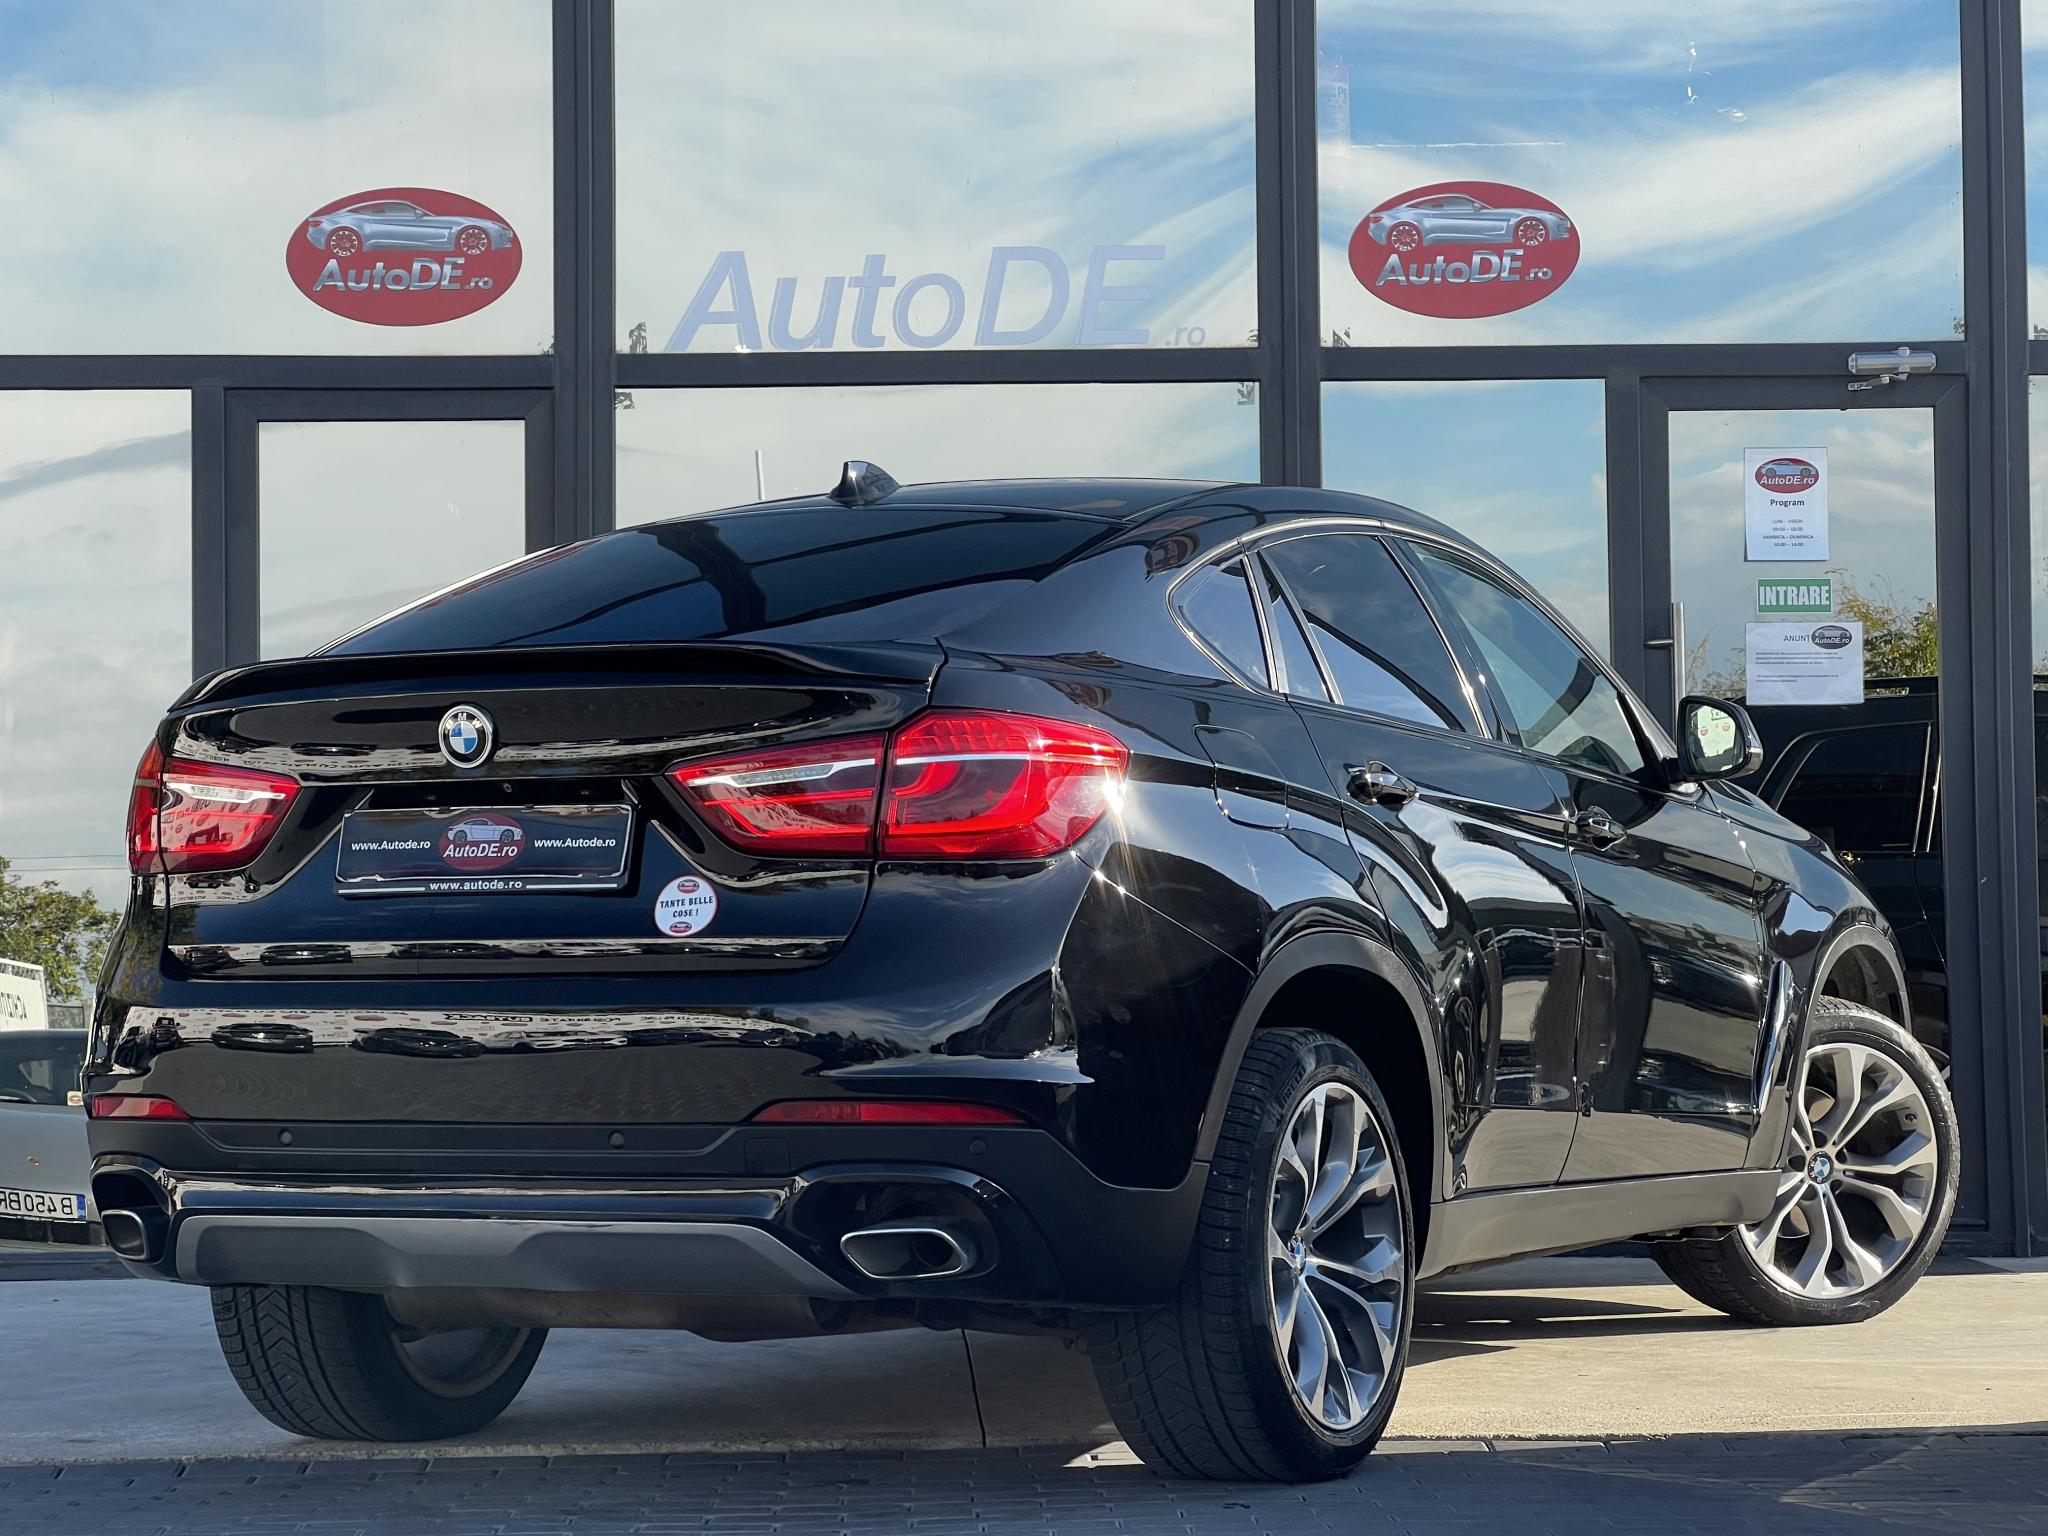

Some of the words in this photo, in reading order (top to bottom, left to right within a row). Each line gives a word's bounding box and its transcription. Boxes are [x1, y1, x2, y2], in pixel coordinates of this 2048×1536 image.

[1760, 475, 1815, 485] AutoDE.ro
[1770, 499, 1805, 508] Program
[1759, 585, 1830, 606] INTRARE
[1814, 637, 1850, 645] AutoDE.ro
[351, 838, 431, 851] www.Autode.ro
[534, 836, 617, 849] www.Autode.ro
[443, 842, 518, 859] AutoDE.ro
[429, 879, 523, 892] www.autode.ro
[660, 898, 686, 909] TANTE
[688, 895, 714, 907] BELLE
[672, 908, 694, 918] COSE
